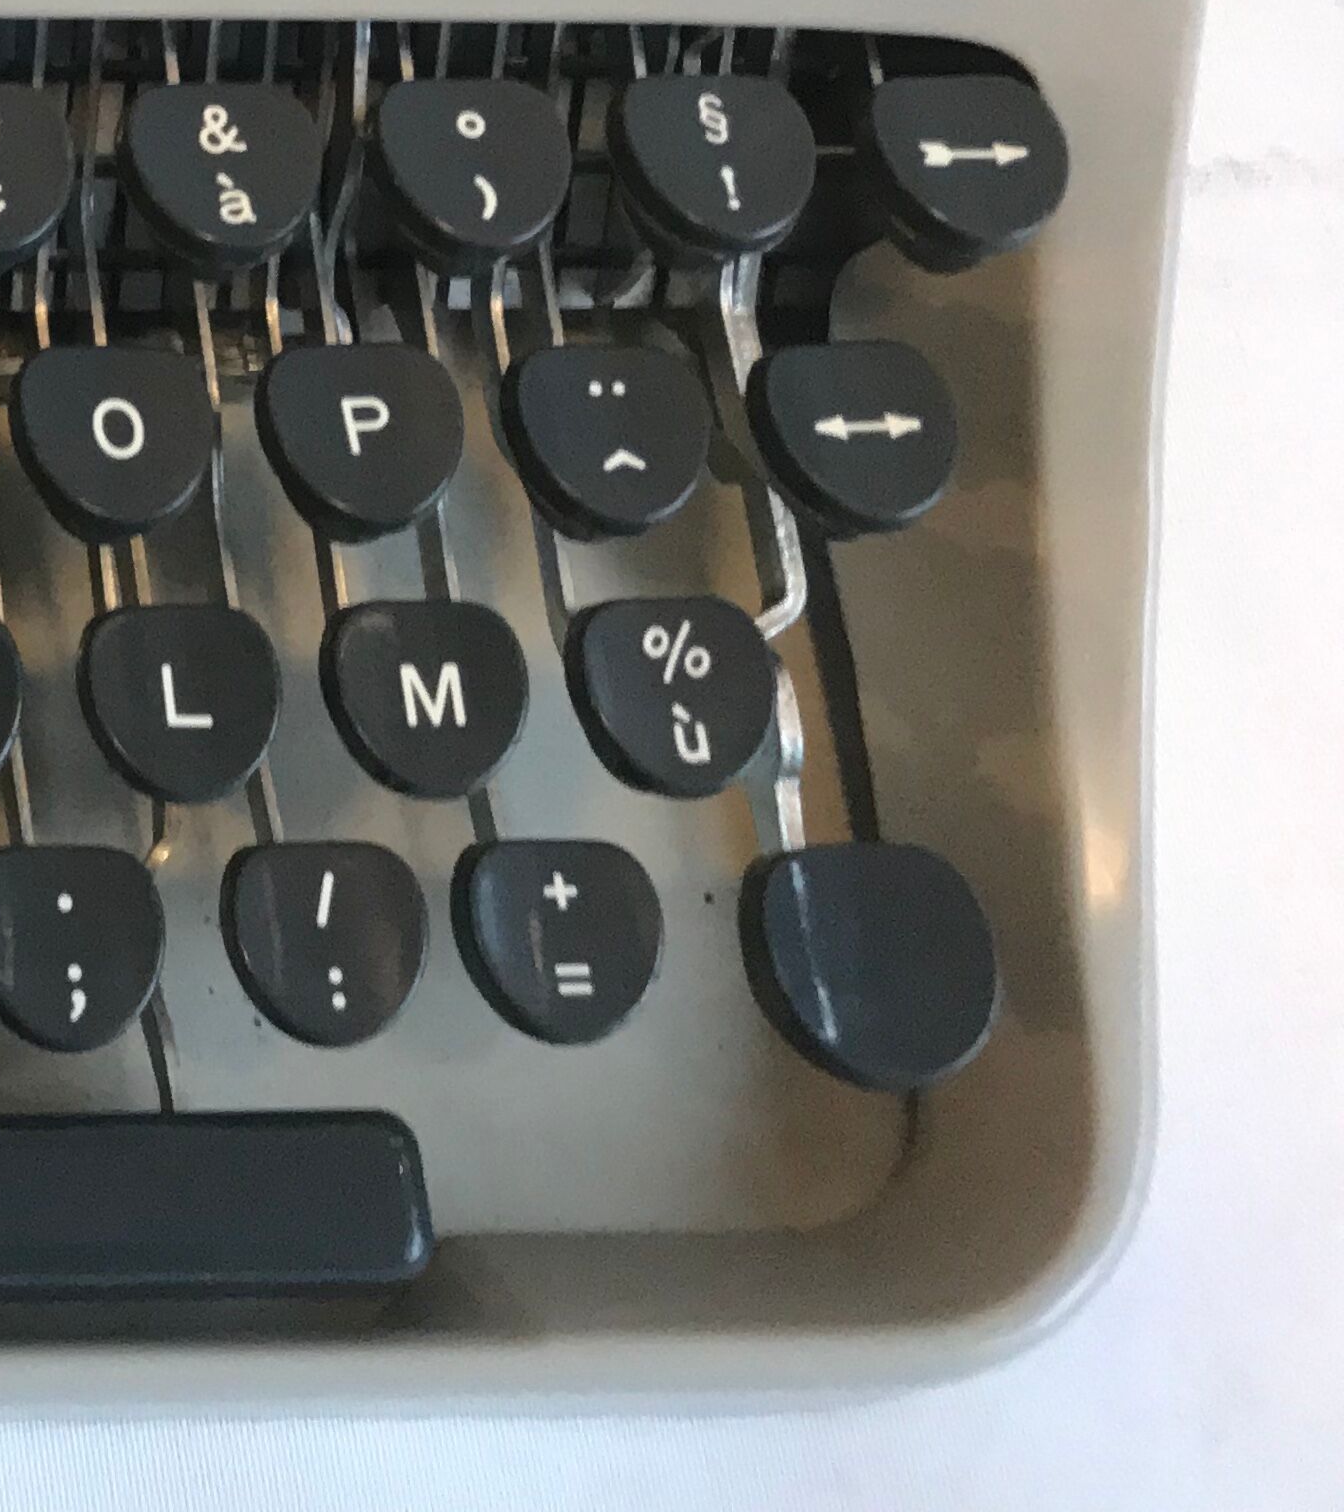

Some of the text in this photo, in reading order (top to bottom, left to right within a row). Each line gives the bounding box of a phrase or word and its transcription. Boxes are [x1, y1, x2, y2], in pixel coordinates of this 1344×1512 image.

[198, 103, 248, 155] &
[215, 171, 258, 226] à
[473, 174, 499, 221] )
[719, 164, 742, 212] !
[91, 396, 146, 461] O
[339, 395, 391, 457] P
[641, 619, 712, 685] %
[160, 662, 214, 729] L
[399, 661, 468, 728] M
[670, 702, 712, 765] ù
[542, 870, 579, 911] +
[66, 962, 87, 1024] ;
[327, 966, 348, 1011] :
[554, 962, 594, 997] =
